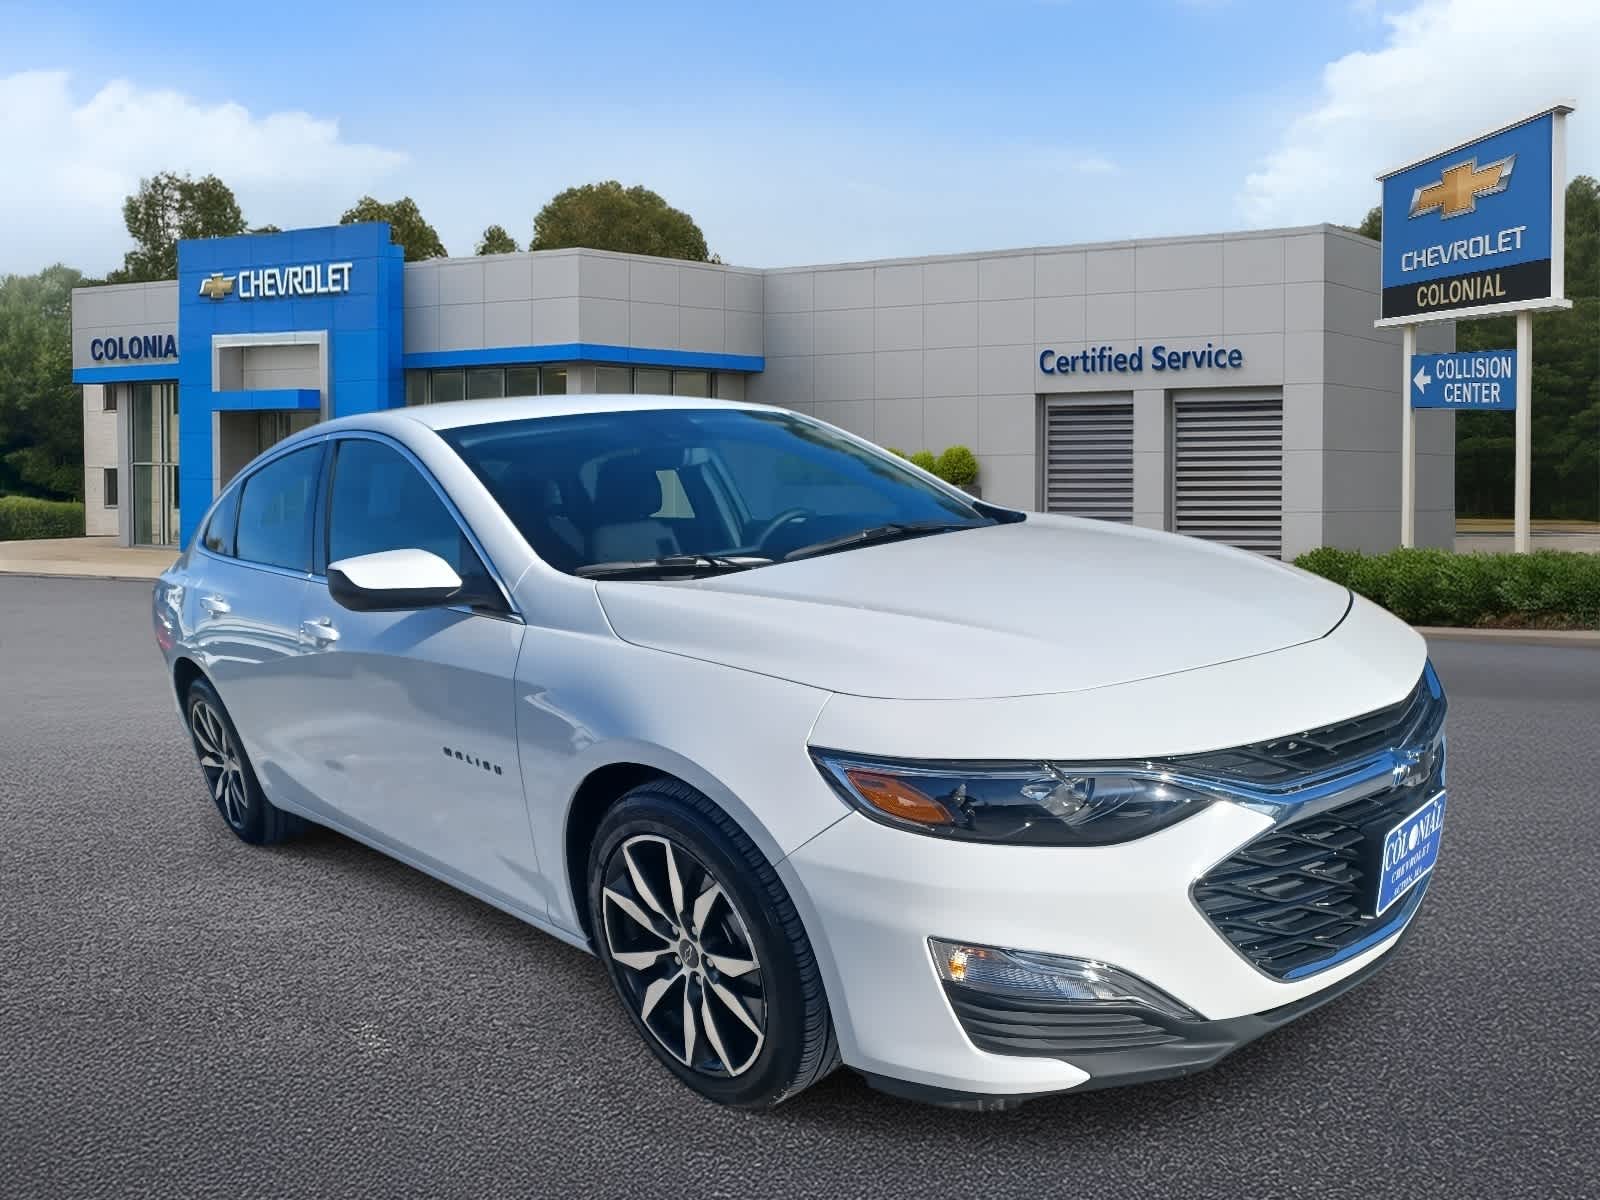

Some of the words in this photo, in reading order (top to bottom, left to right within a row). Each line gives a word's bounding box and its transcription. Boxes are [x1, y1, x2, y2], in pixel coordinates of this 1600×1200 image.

[1401, 225, 1527, 273] CHEVROLET
[238, 262, 352, 299] CHEVROLET
[1416, 273, 1506, 307] COLONIAL
[90, 334, 178, 361] COLONIA
[1039, 345, 1144, 374] Certified
[1151, 343, 1243, 372] Service
[1436, 356, 1512, 380] COLLISION
[1444, 382, 1500, 403] CENTER
[443, 746, 502, 776] MALIBU
